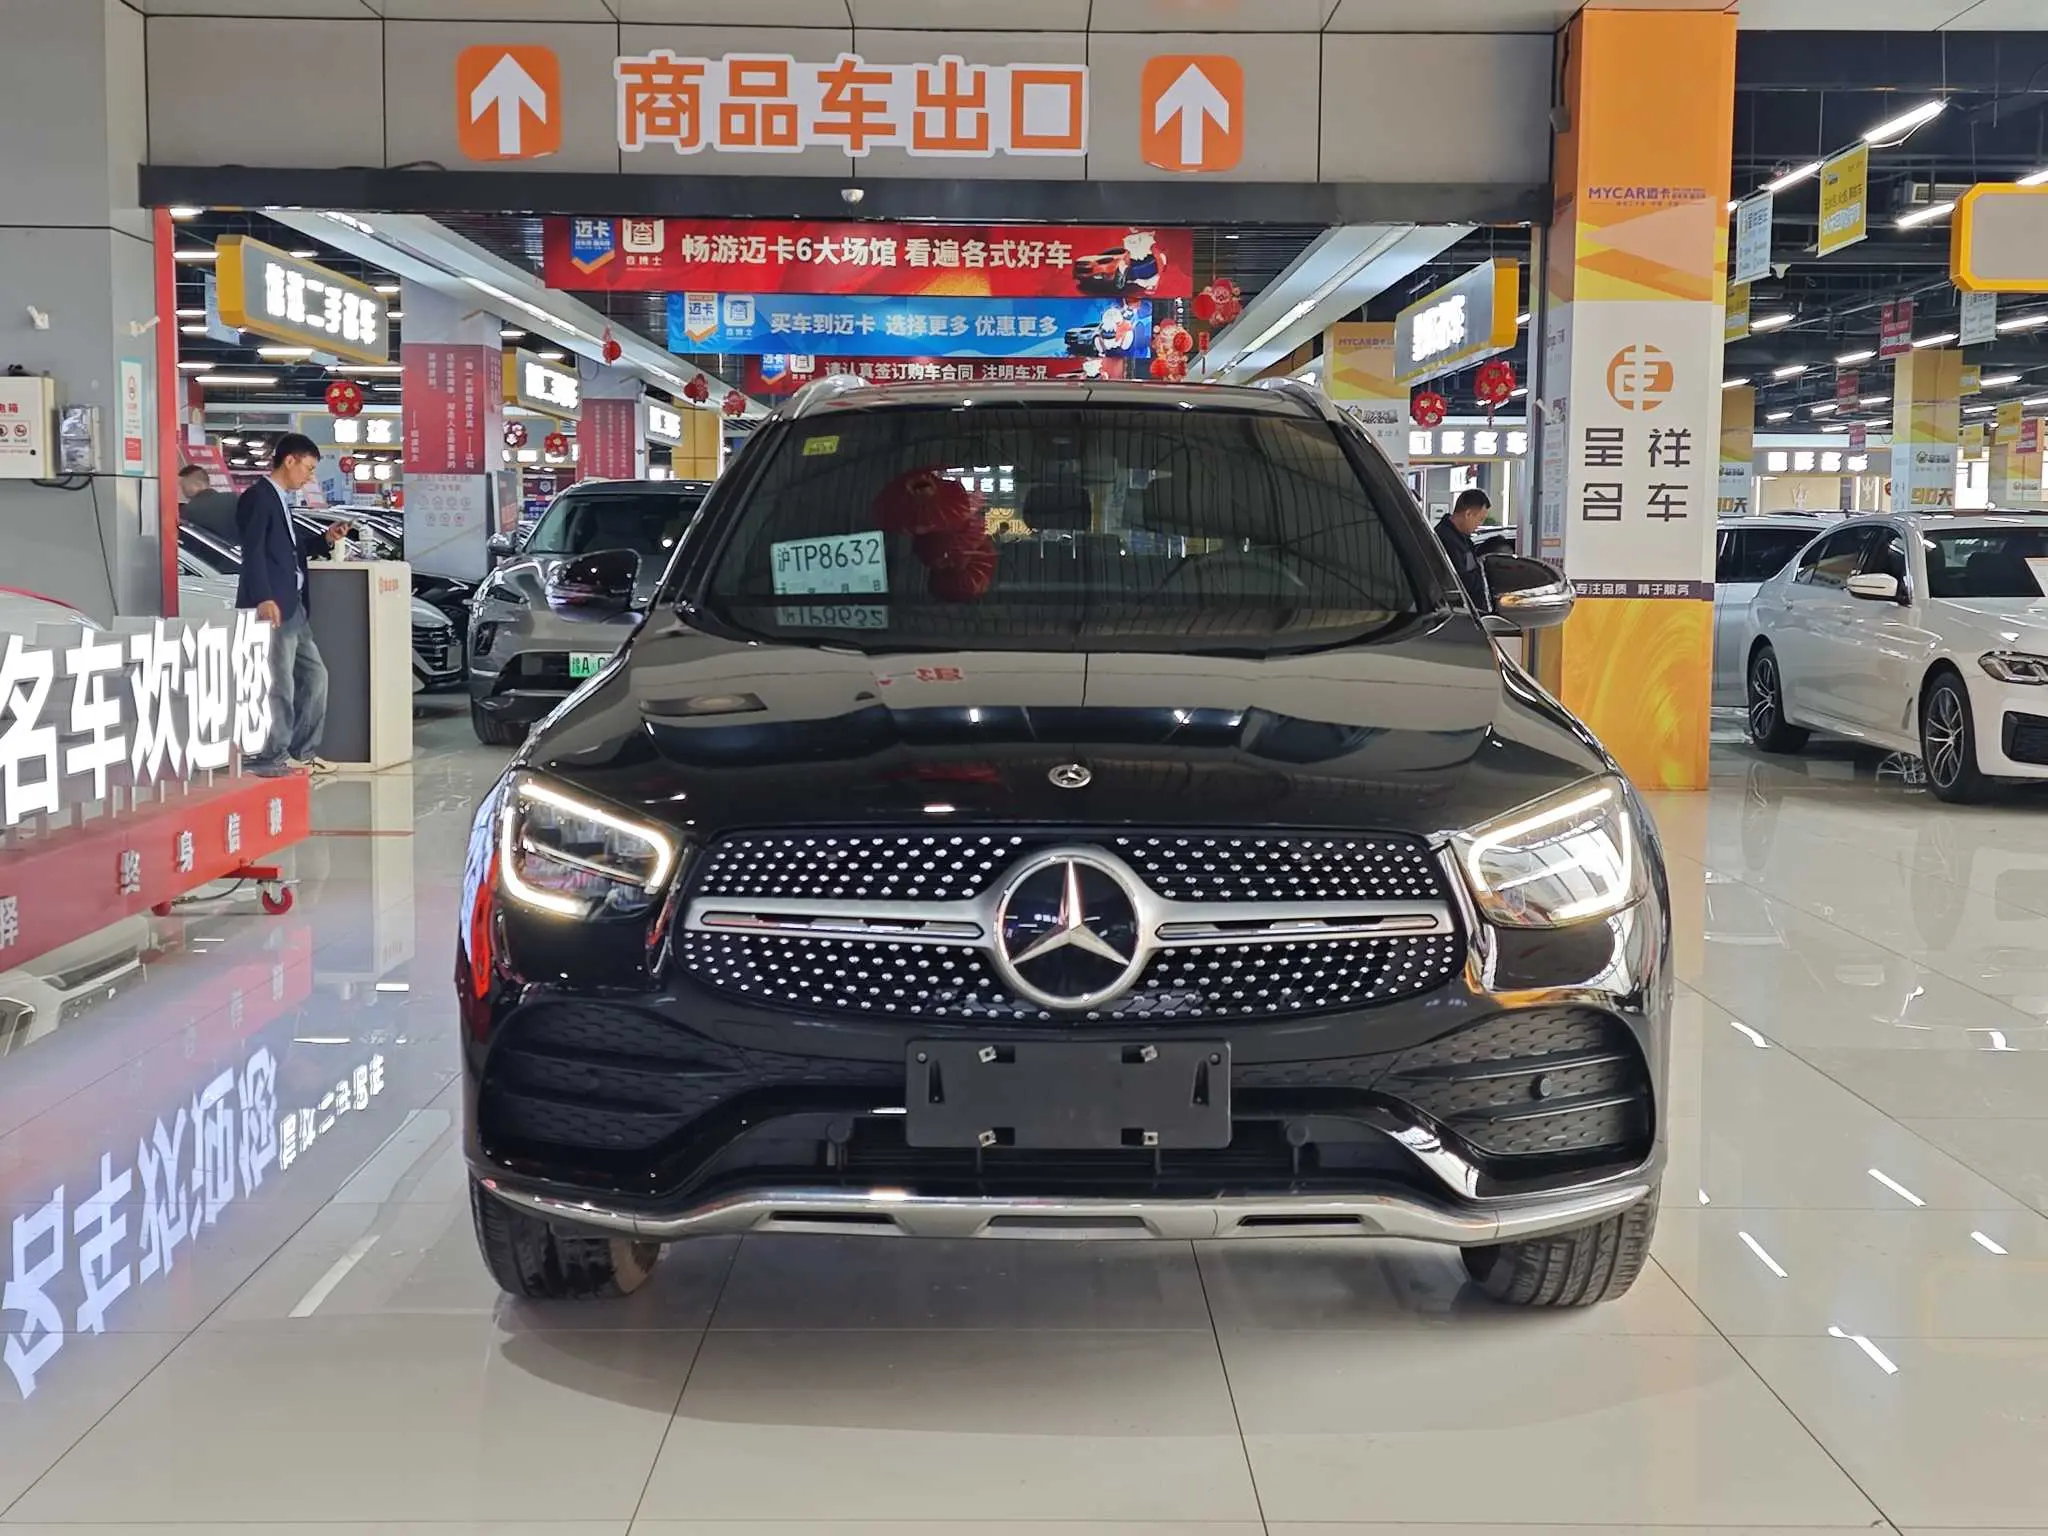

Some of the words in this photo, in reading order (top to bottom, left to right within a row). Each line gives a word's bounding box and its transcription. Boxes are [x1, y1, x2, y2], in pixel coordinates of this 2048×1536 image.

[617, 54, 1085, 152] 商品车出口
[575, 220, 610, 238] 迈卡
[681, 236, 897, 268] 畅游迈卡6大场馆
[904, 238, 1073, 270] 看遍各式好车
[688, 302, 716, 316] 迈卡
[770, 312, 877, 336] 买车到迈卡
[885, 314, 968, 337] 选择更多
[975, 314, 1059, 338] 优惠更多
[981, 363, 1048, 381] 注明车况
[1584, 428, 1692, 468] 呈祥
[1583, 483, 1689, 523] 名车
[1718, 497, 1748, 513] 0天
[778, 539, 881, 572] 沪TP8632
[0, 609, 273, 826] 名车欢迎您
